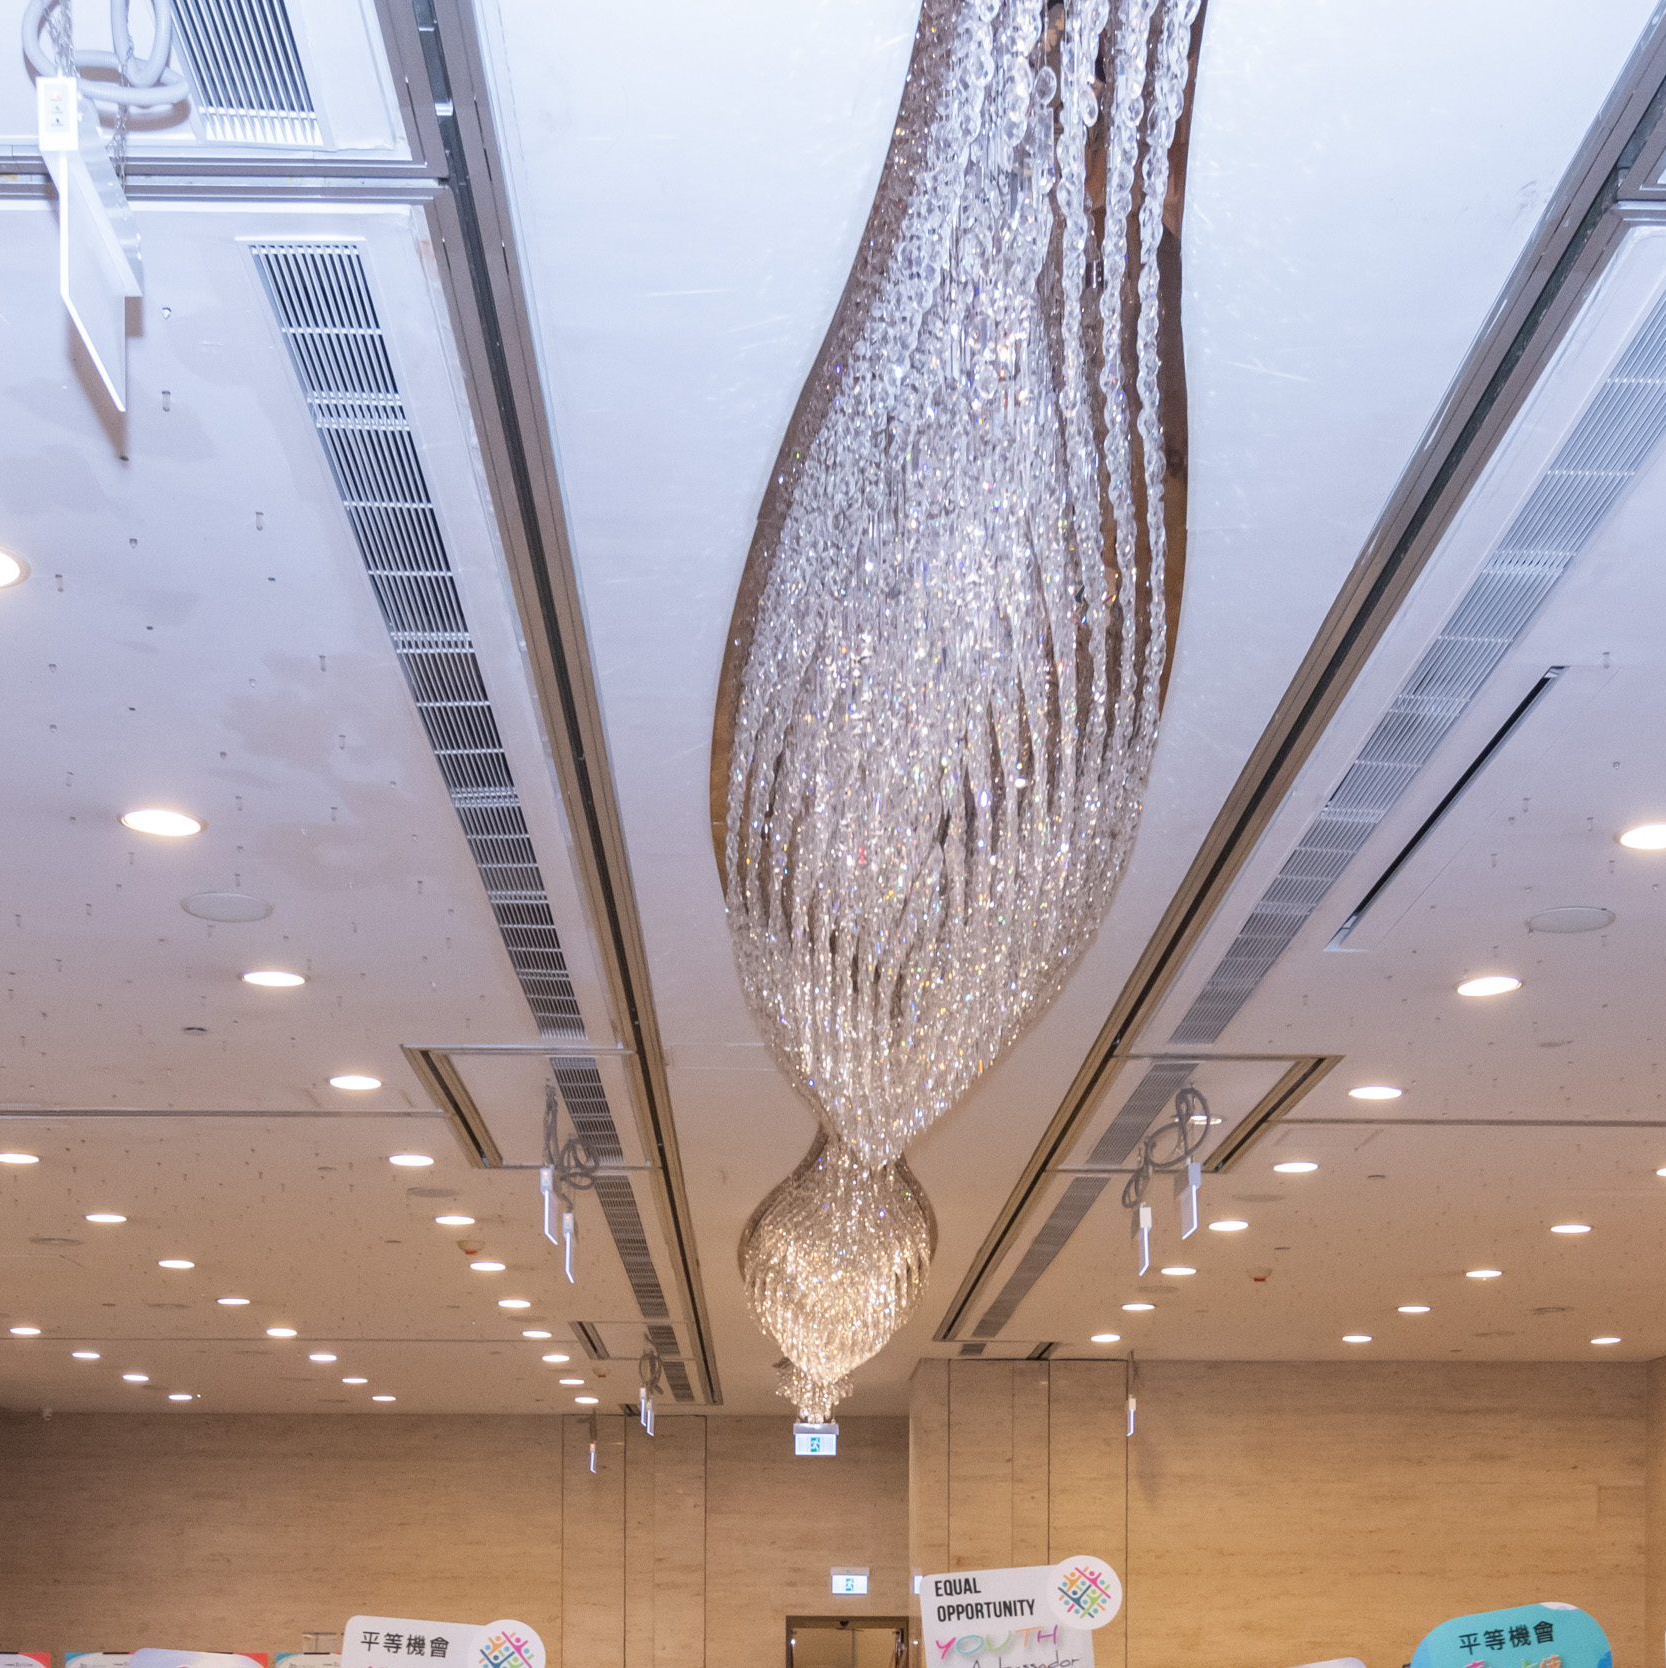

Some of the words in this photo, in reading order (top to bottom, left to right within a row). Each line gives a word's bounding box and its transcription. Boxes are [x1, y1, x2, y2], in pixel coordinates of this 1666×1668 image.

[934, 1577, 981, 1597] EQUAL
[937, 1598, 1035, 1623] OPPORTUNITY
[361, 1631, 450, 1659] 平等機會
[935, 1624, 1058, 1659] YOUTH
[1459, 1620, 1554, 1655] 平等機會
